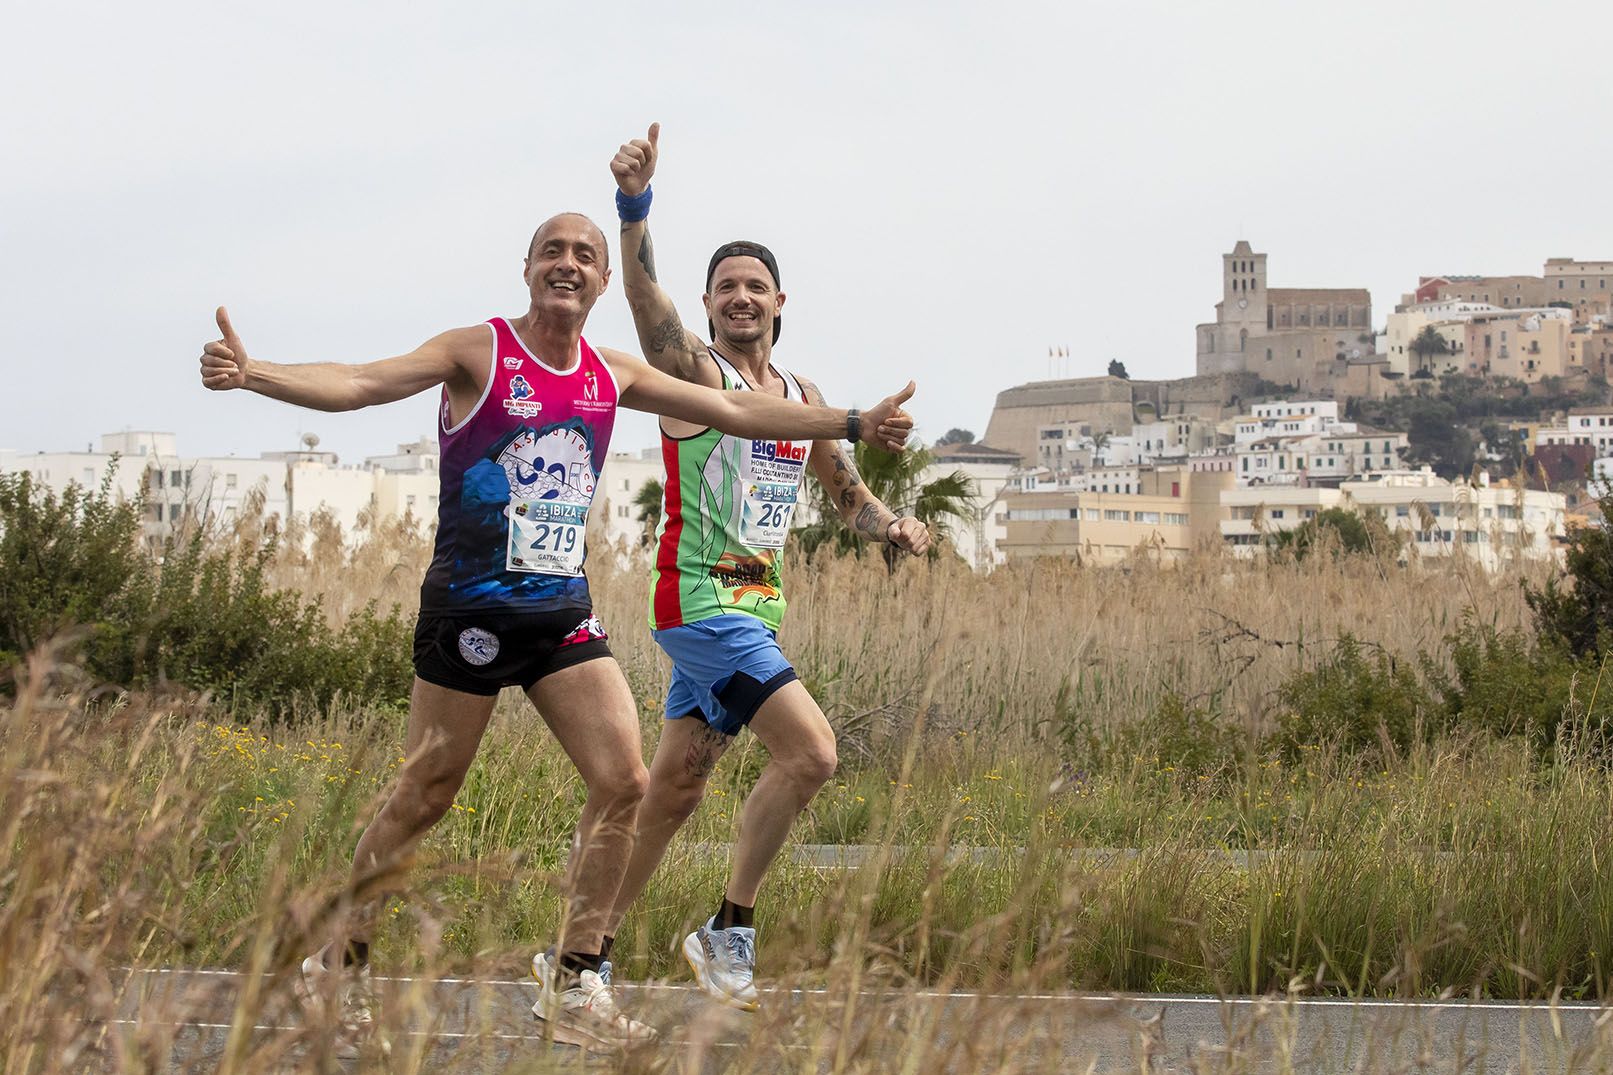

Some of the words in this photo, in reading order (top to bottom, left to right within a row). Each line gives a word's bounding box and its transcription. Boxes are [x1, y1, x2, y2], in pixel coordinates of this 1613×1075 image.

[751, 460, 767, 468] HOME
[774, 485, 792, 497] IBIZA
[550, 504, 577, 517] IBIZA
[757, 503, 790, 528] 261
[530, 524, 576, 553] 219
[537, 553, 570, 563] GATTACCIO
